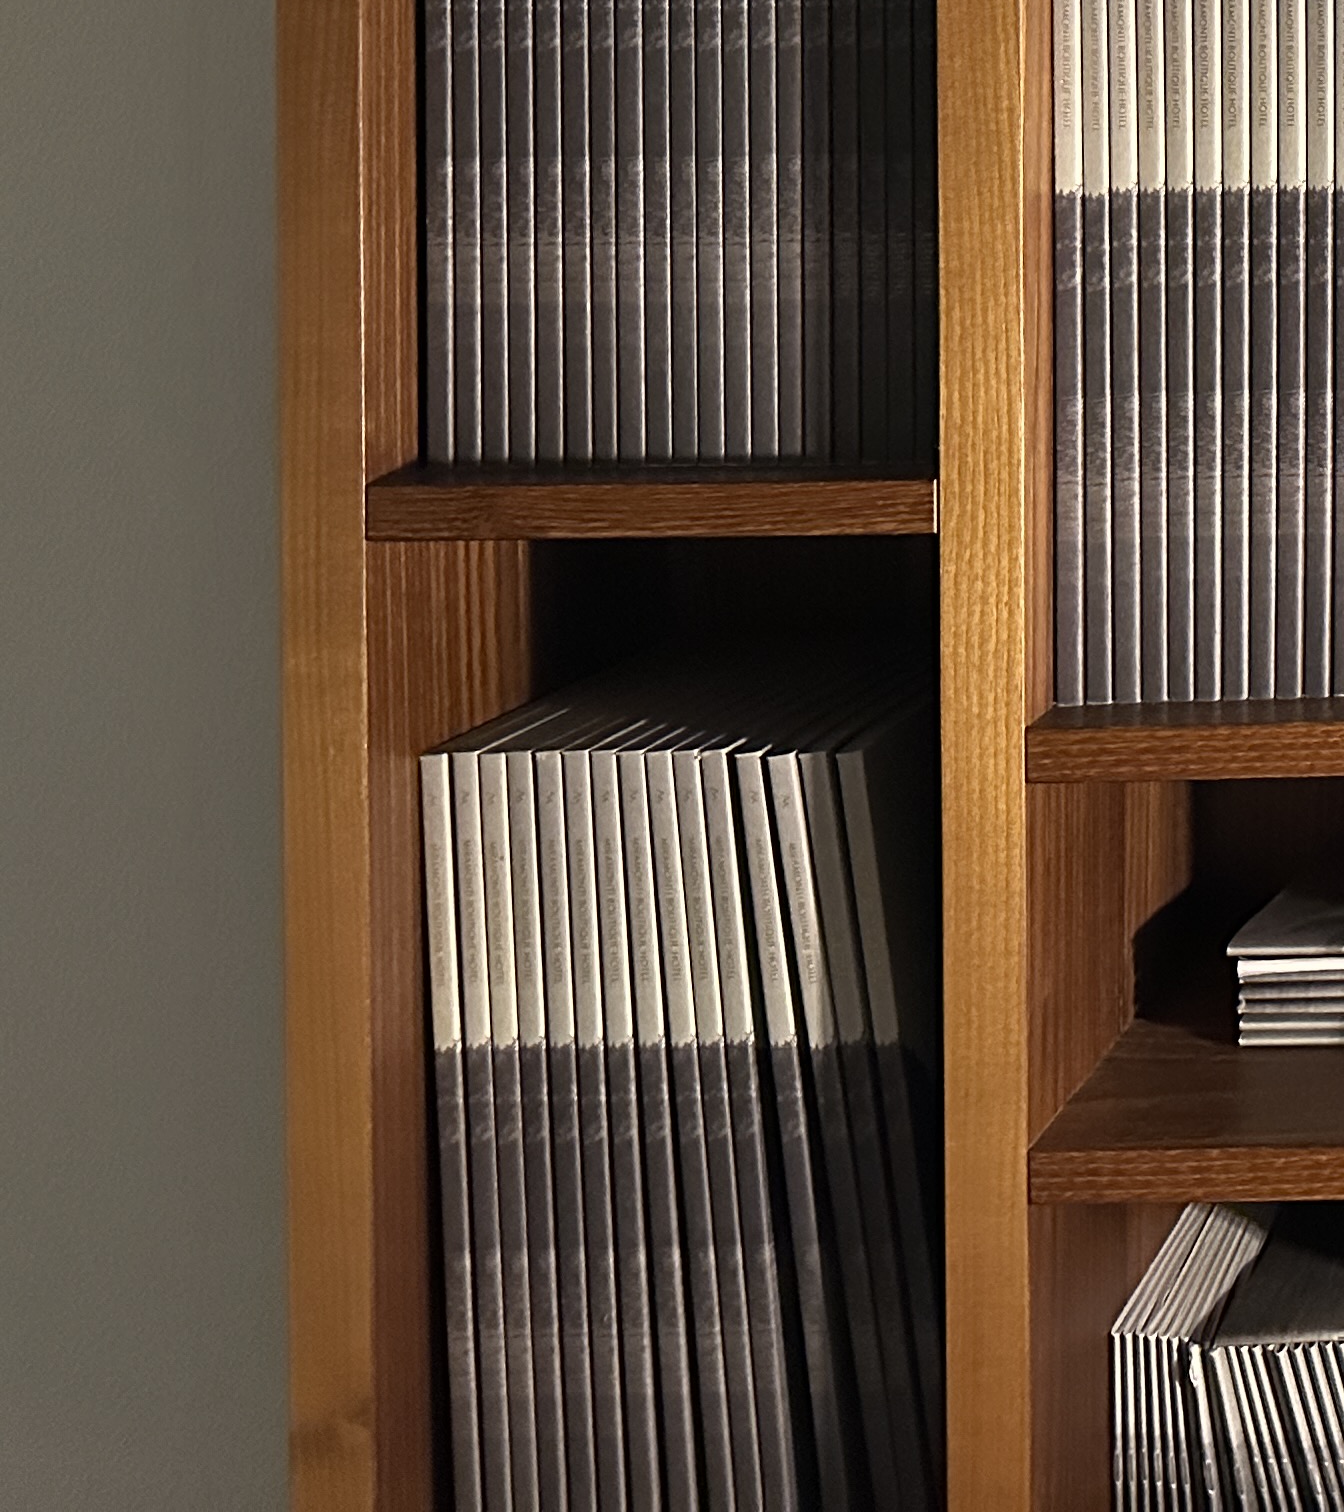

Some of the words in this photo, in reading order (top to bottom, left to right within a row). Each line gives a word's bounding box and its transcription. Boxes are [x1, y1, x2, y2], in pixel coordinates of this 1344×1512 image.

[1091, 48, 1099, 97] BOUTIQUE
[1117, 45, 1125, 94] BOUTIQUE
[1145, 46, 1153, 96] BOUTIQUE
[1172, 45, 1180, 94] BOUTIQUE
[1200, 45, 1208, 96] BOUTIQUE
[1228, 45, 1236, 94] BOUTIQUE
[1258, 44, 1267, 93] BOUTIQUE
[1286, 45, 1294, 93] BOUTIQUE
[1317, 44, 1325, 93] BOUTIQUE
[1063, 98, 1071, 128] HOTEL
[1092, 102, 1100, 131] HOTEL
[1172, 99, 1180, 129] HOTEL
[1228, 98, 1236, 130] HOTEL
[1259, 97, 1267, 127] HOTEL
[1286, 97, 1294, 127] HOTEL
[1317, 97, 1326, 127] HOTEL
